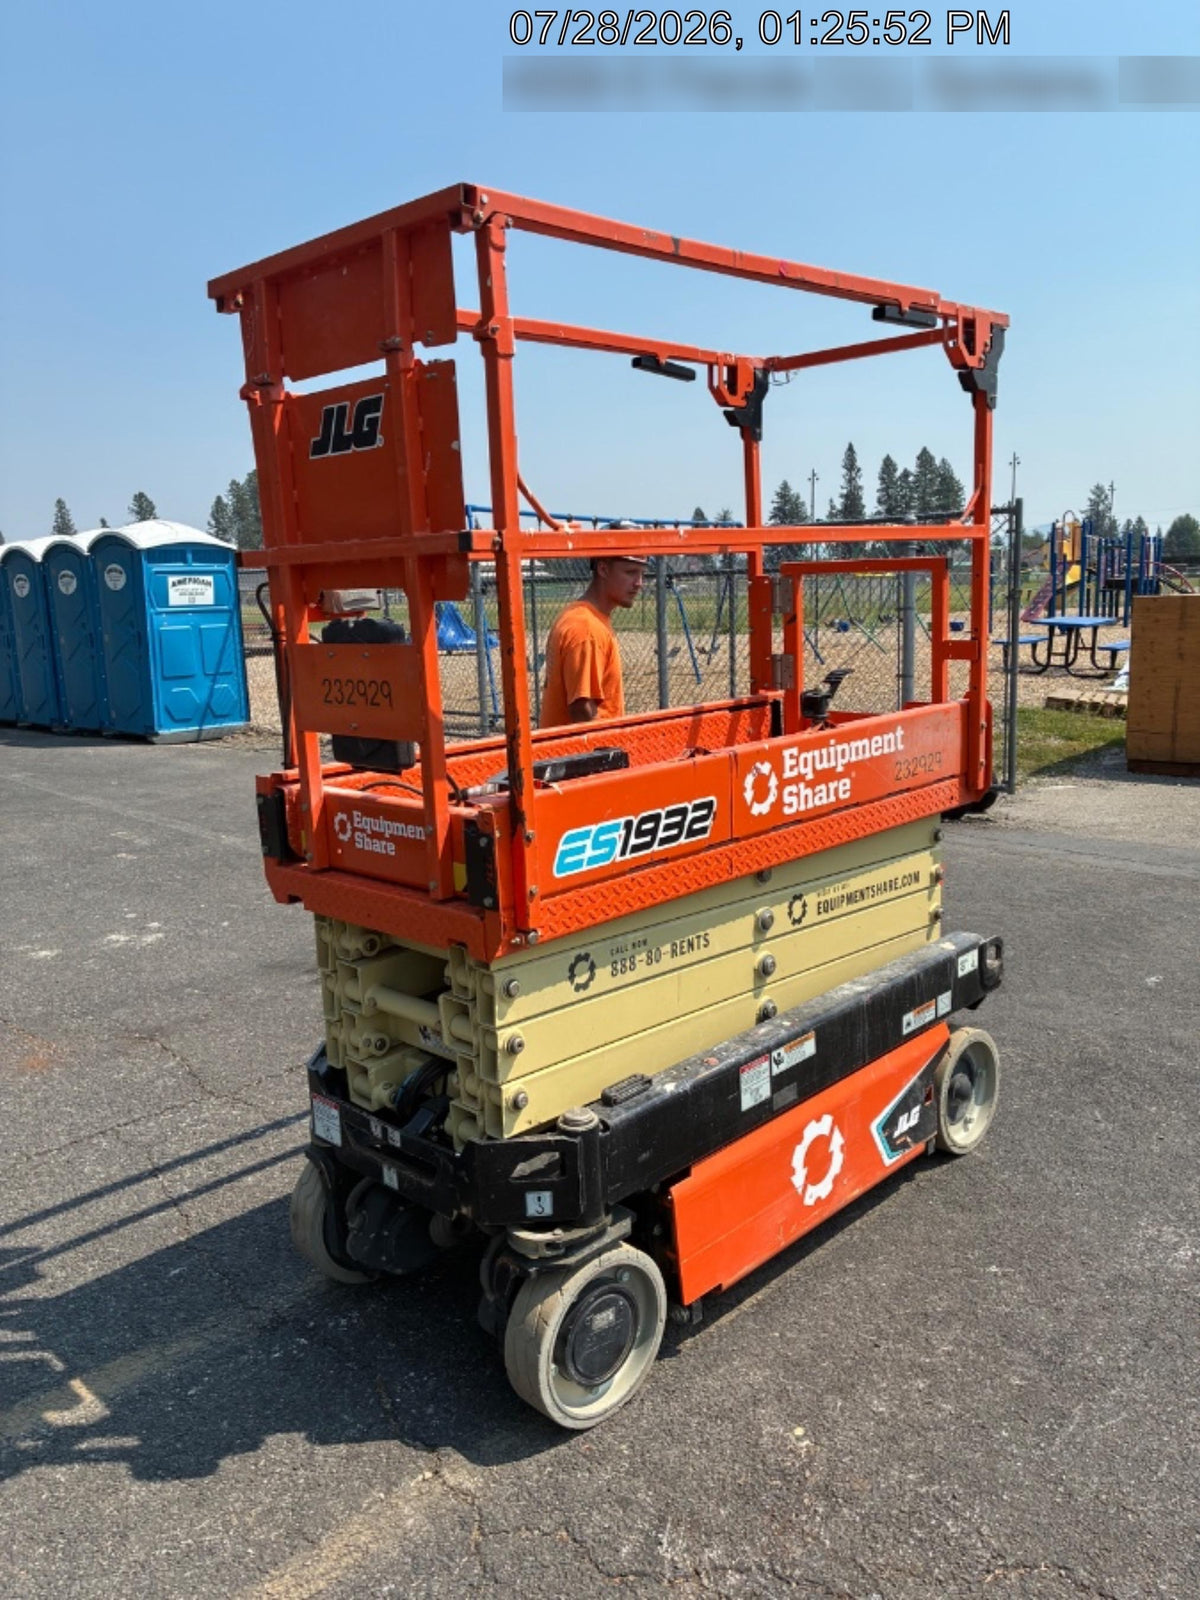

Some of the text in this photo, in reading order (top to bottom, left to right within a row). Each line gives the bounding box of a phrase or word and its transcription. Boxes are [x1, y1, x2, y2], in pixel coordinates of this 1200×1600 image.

[309, 393, 385, 460] JLG
[322, 678, 394, 711] 232929
[782, 725, 904, 780] Equipment
[894, 751, 942, 781] 232929
[782, 778, 851, 815] Share
[353, 809, 426, 841] Equipmen
[354, 831, 396, 856] Share
[553, 796, 717, 878] ES1932
[817, 870, 920, 916] EQUIPMENTSHARE.COM
[610, 932, 711, 978] 888-80-RENTS
[892, 1103, 921, 1139] JLG
